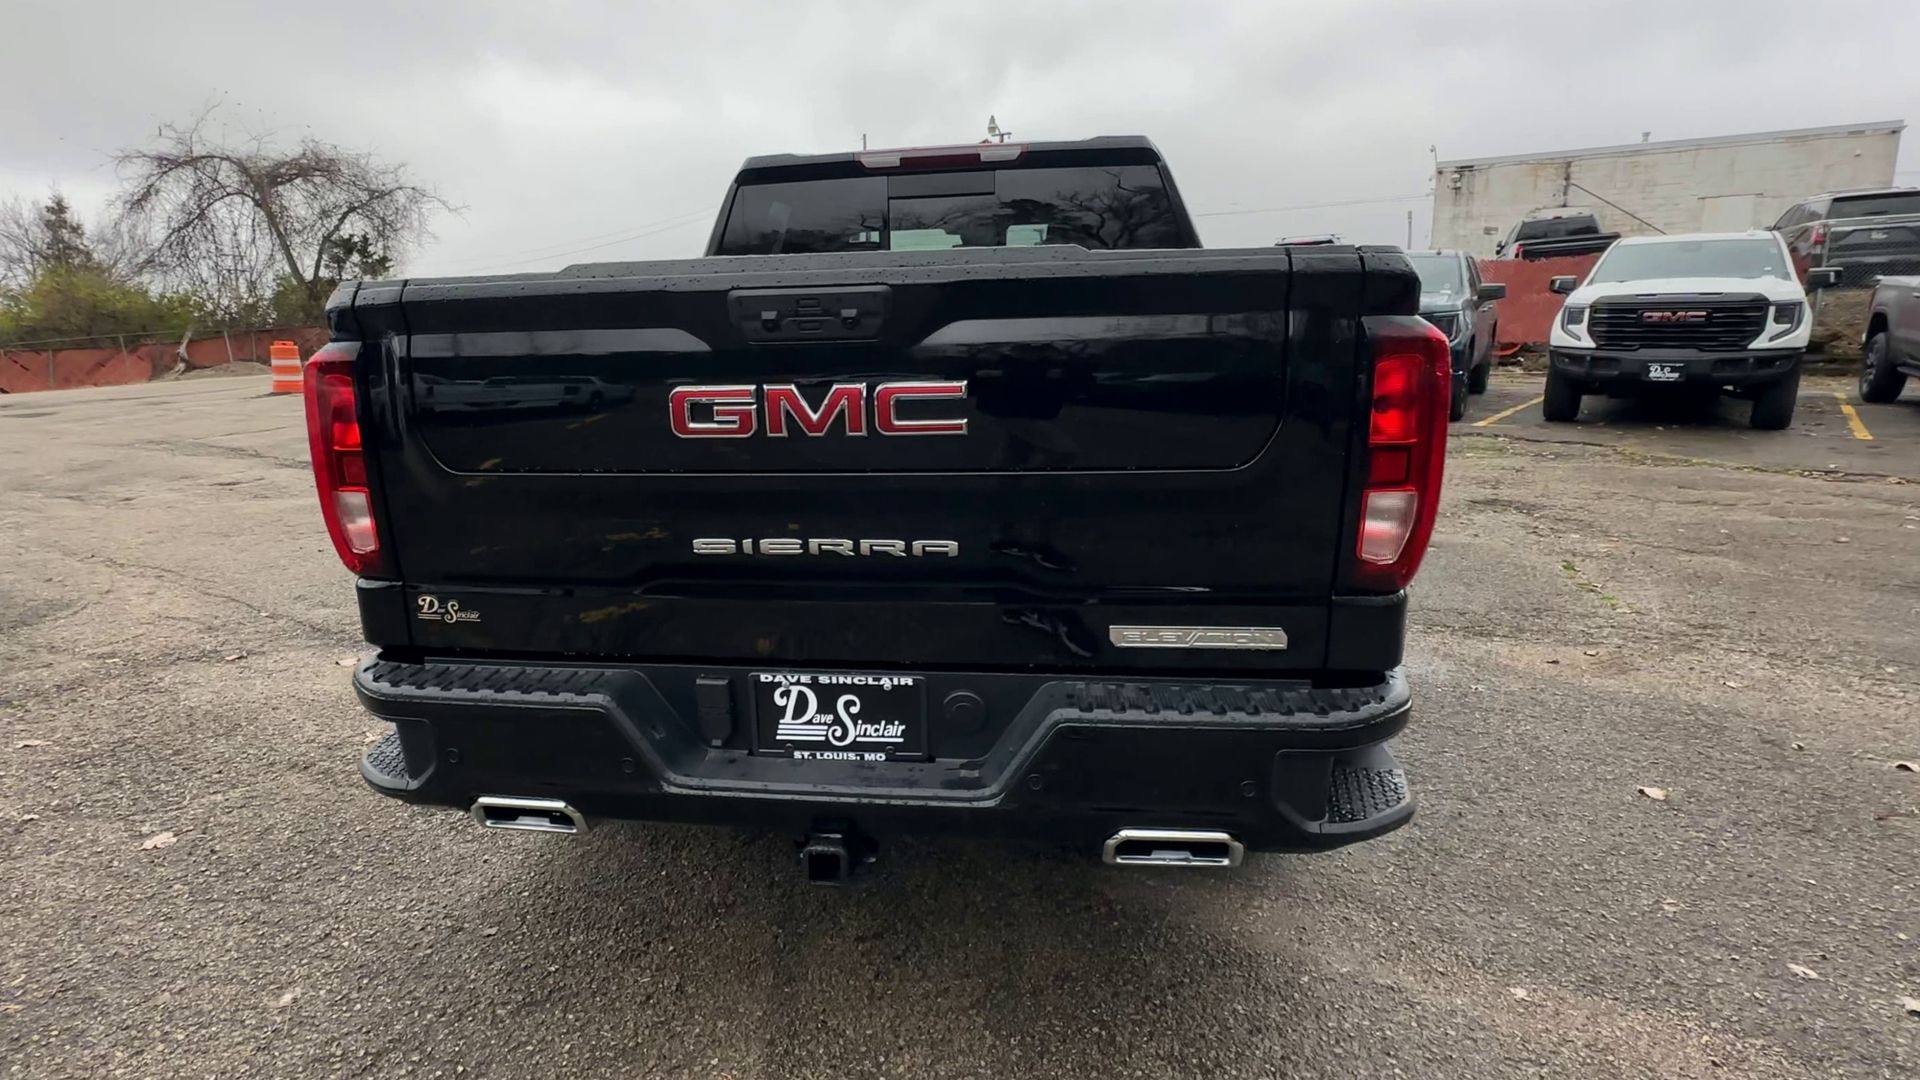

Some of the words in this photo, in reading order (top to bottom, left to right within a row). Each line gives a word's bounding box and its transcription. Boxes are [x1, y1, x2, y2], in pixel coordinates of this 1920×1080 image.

[1643, 311, 1707, 322] GMC
[669, 380, 968, 438] GMC
[692, 538, 959, 557] SIERRA
[759, 673, 812, 684] DAVE
[817, 676, 914, 686] SINCLAIR
[773, 685, 834, 725] Dave
[827, 694, 906, 747] Sinclair
[793, 751, 813, 760] ST.
[864, 752, 886, 762] MO
